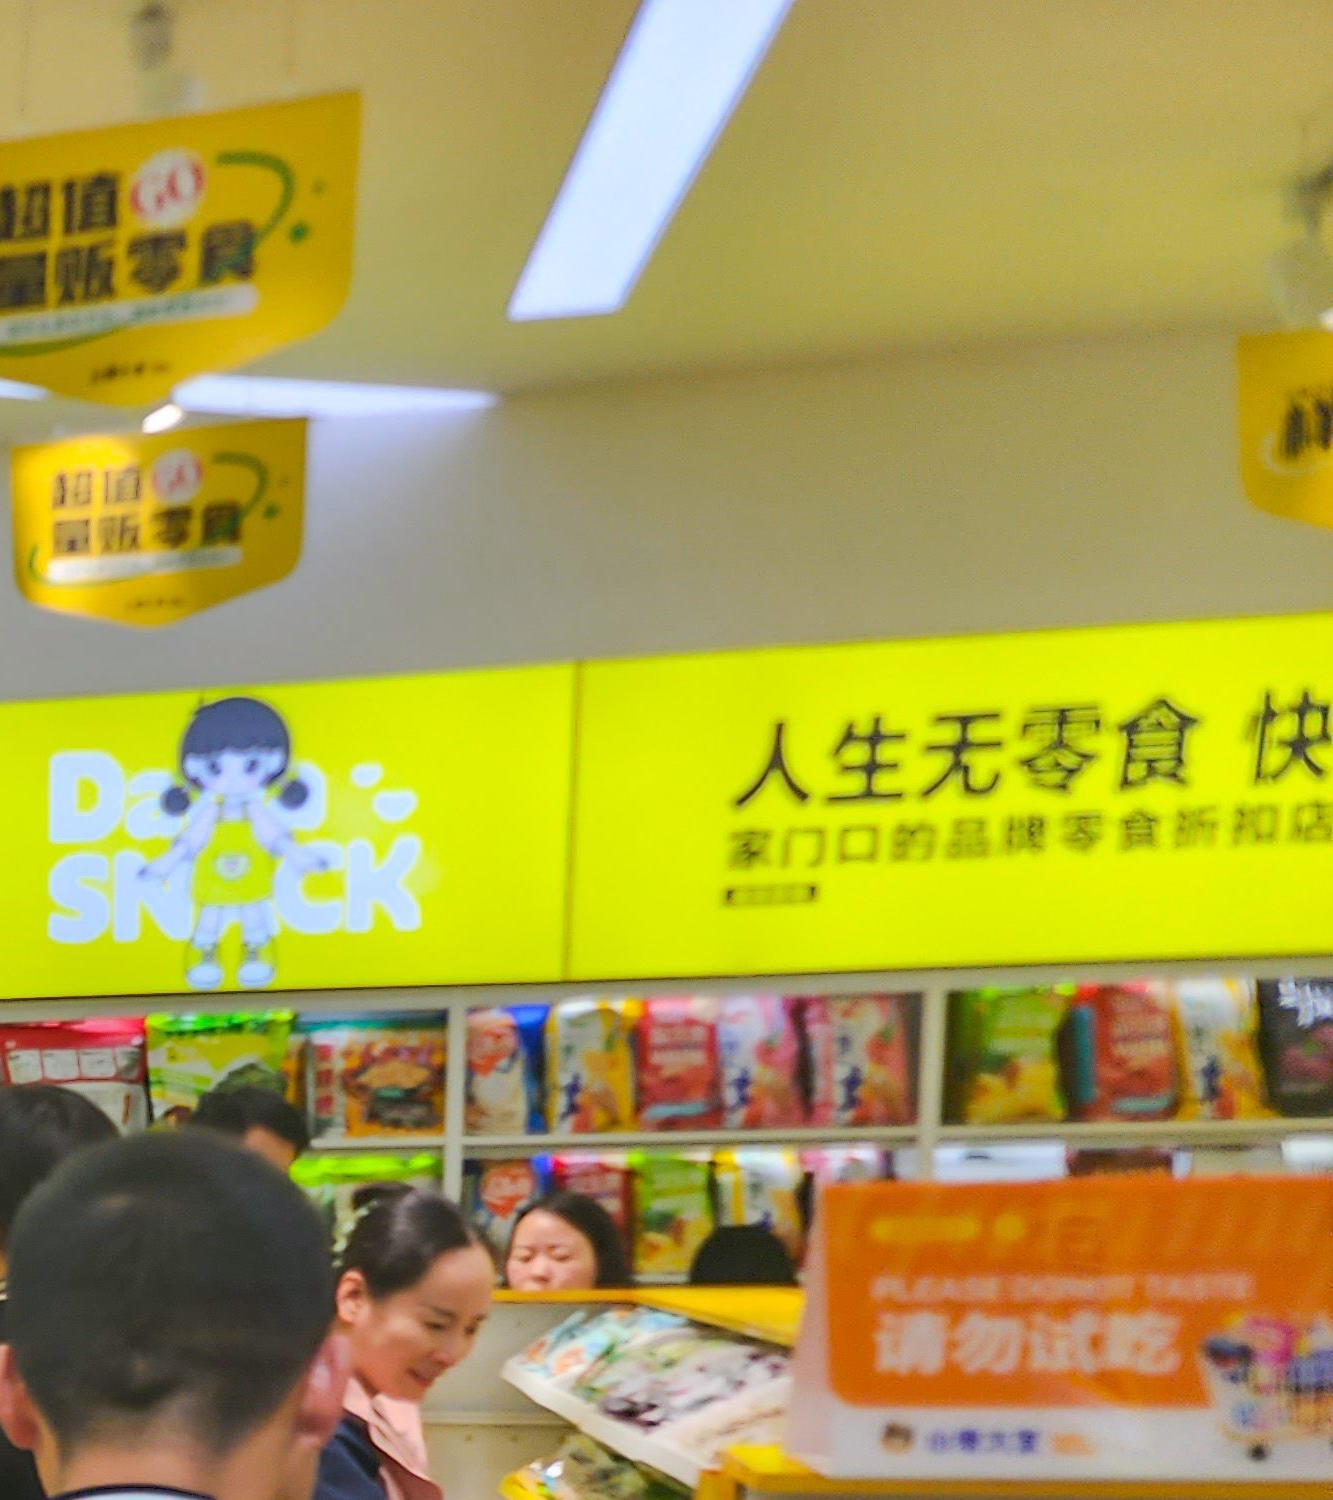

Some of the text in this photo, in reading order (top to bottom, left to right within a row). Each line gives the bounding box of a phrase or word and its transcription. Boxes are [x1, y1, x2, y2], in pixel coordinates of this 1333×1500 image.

[734, 687, 1333, 810] 人生无零食 快
[727, 802, 1333, 872] 家门口的品牌零食折扣店
[46, 835, 422, 944] SNCK
[876, 1310, 1183, 1375] 请勿试吃
